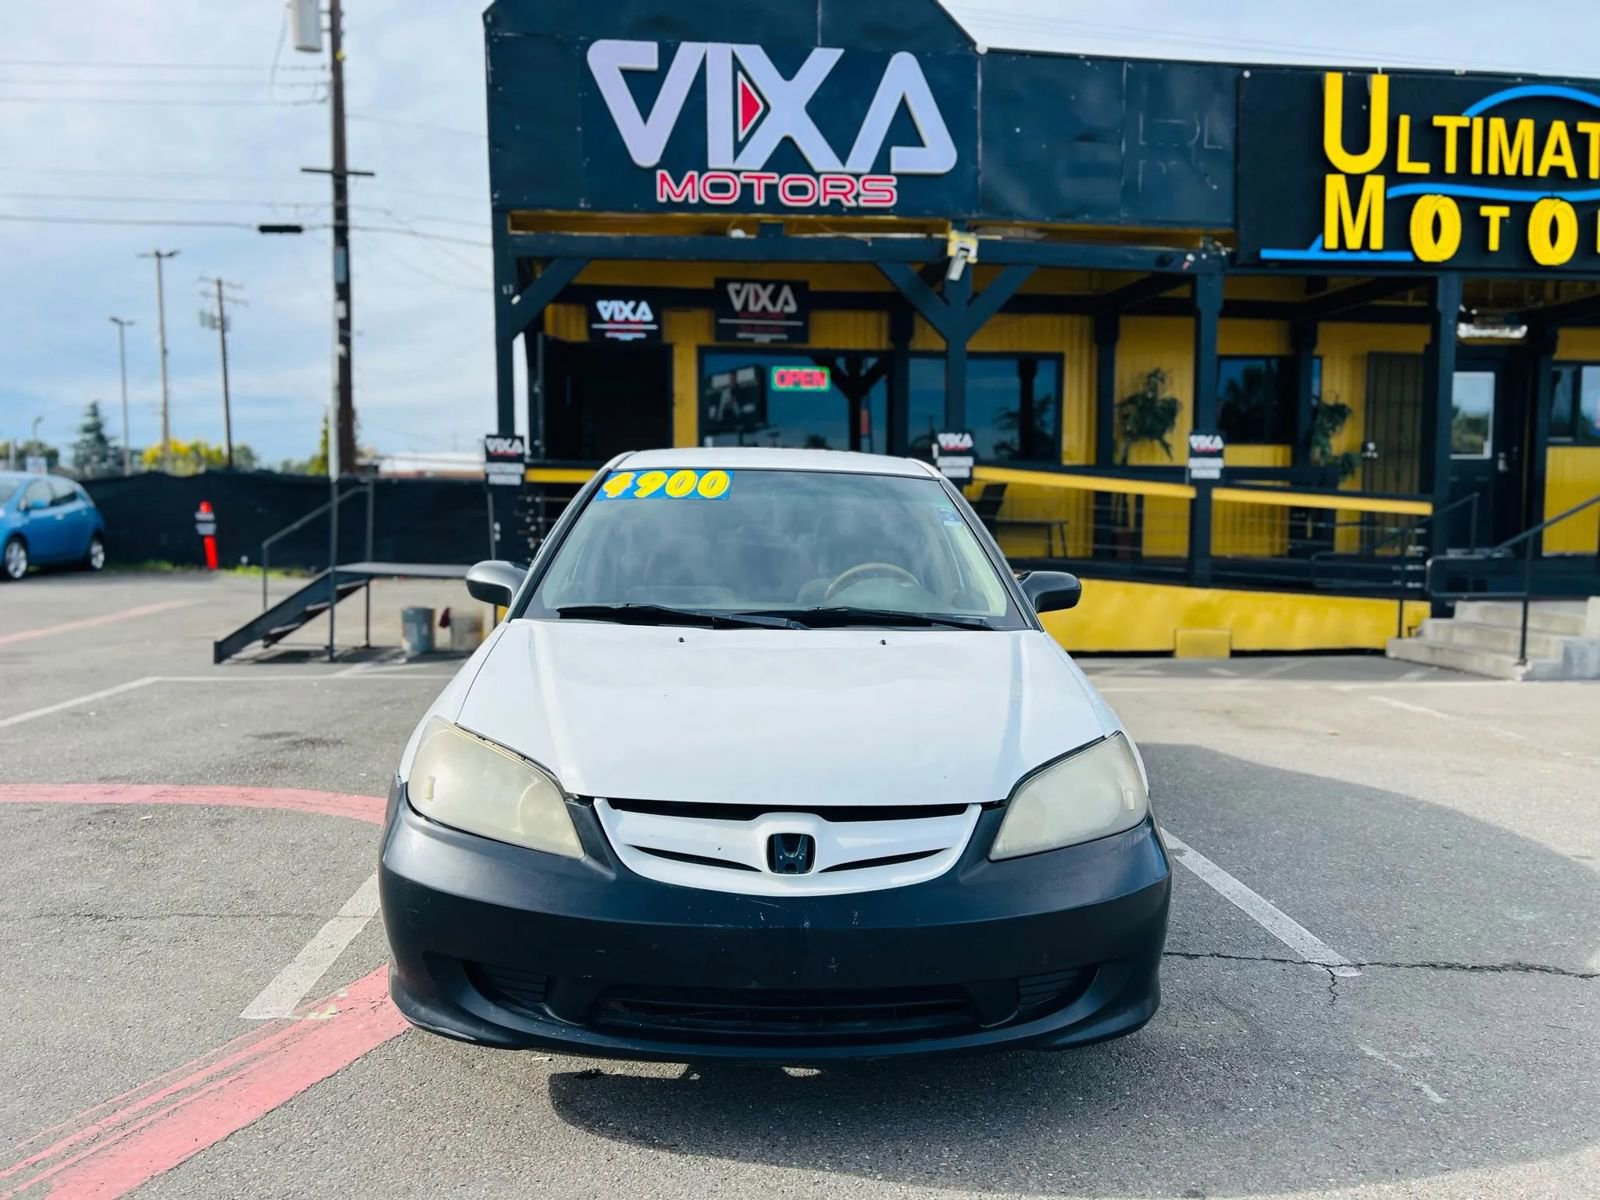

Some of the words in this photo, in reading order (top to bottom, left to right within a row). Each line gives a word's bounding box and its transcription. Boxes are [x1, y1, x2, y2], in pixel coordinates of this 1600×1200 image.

[587, 39, 957, 174] VIXA
[656, 170, 898, 207] MOTORS
[1324, 174, 1600, 266] MOTO
[596, 300, 654, 322] VIXA
[727, 283, 797, 313] VIXA
[775, 369, 827, 388] OPEN
[603, 470, 730, 498] 4900
